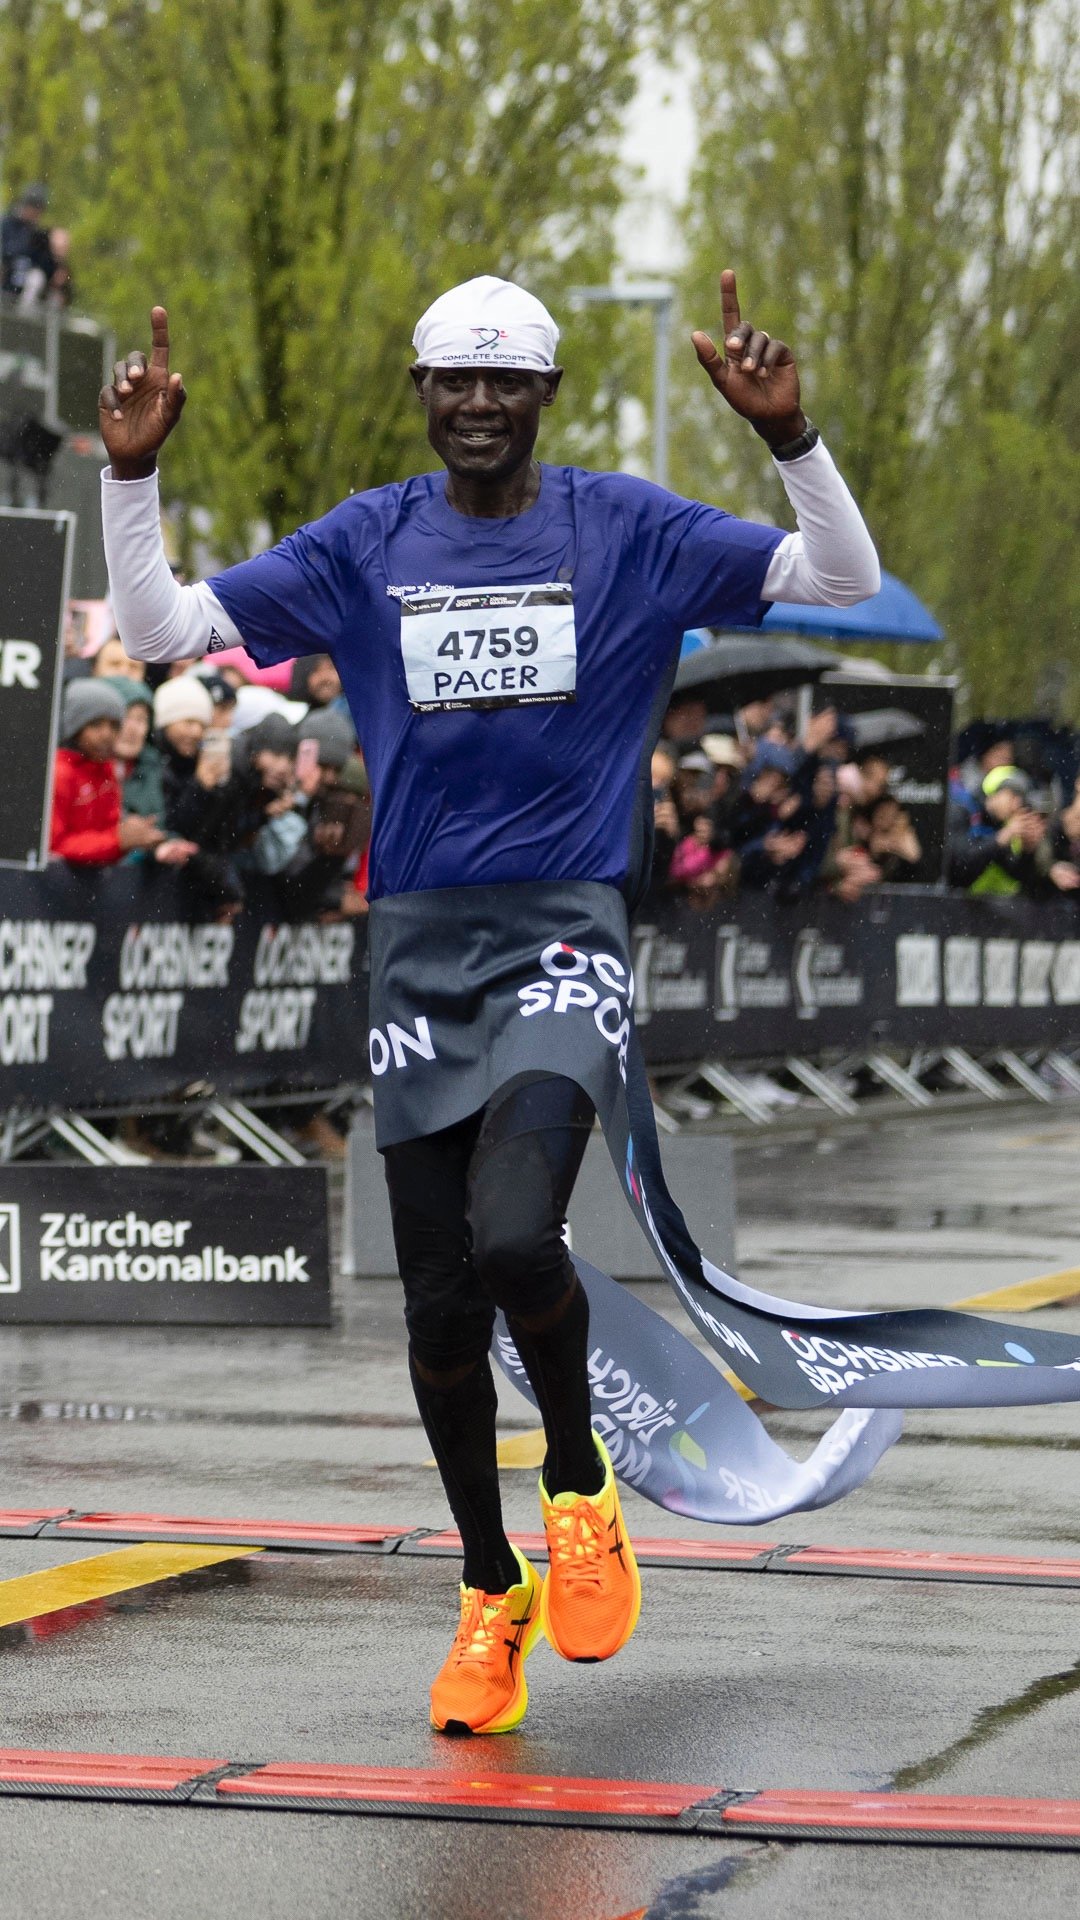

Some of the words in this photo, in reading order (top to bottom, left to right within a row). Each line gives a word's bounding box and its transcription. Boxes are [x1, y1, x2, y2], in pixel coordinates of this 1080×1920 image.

[441, 353, 491, 361] COMPLETE
[493, 353, 527, 362] SPORTS
[437, 625, 539, 661] 4759
[0, 638, 42, 690] R
[434, 665, 539, 697] PACER
[102, 990, 184, 1062] SPORT
[234, 985, 318, 1053] SPORT
[39, 1211, 192, 1249] Zürcher
[39, 1246, 311, 1283] Kantonalbank
